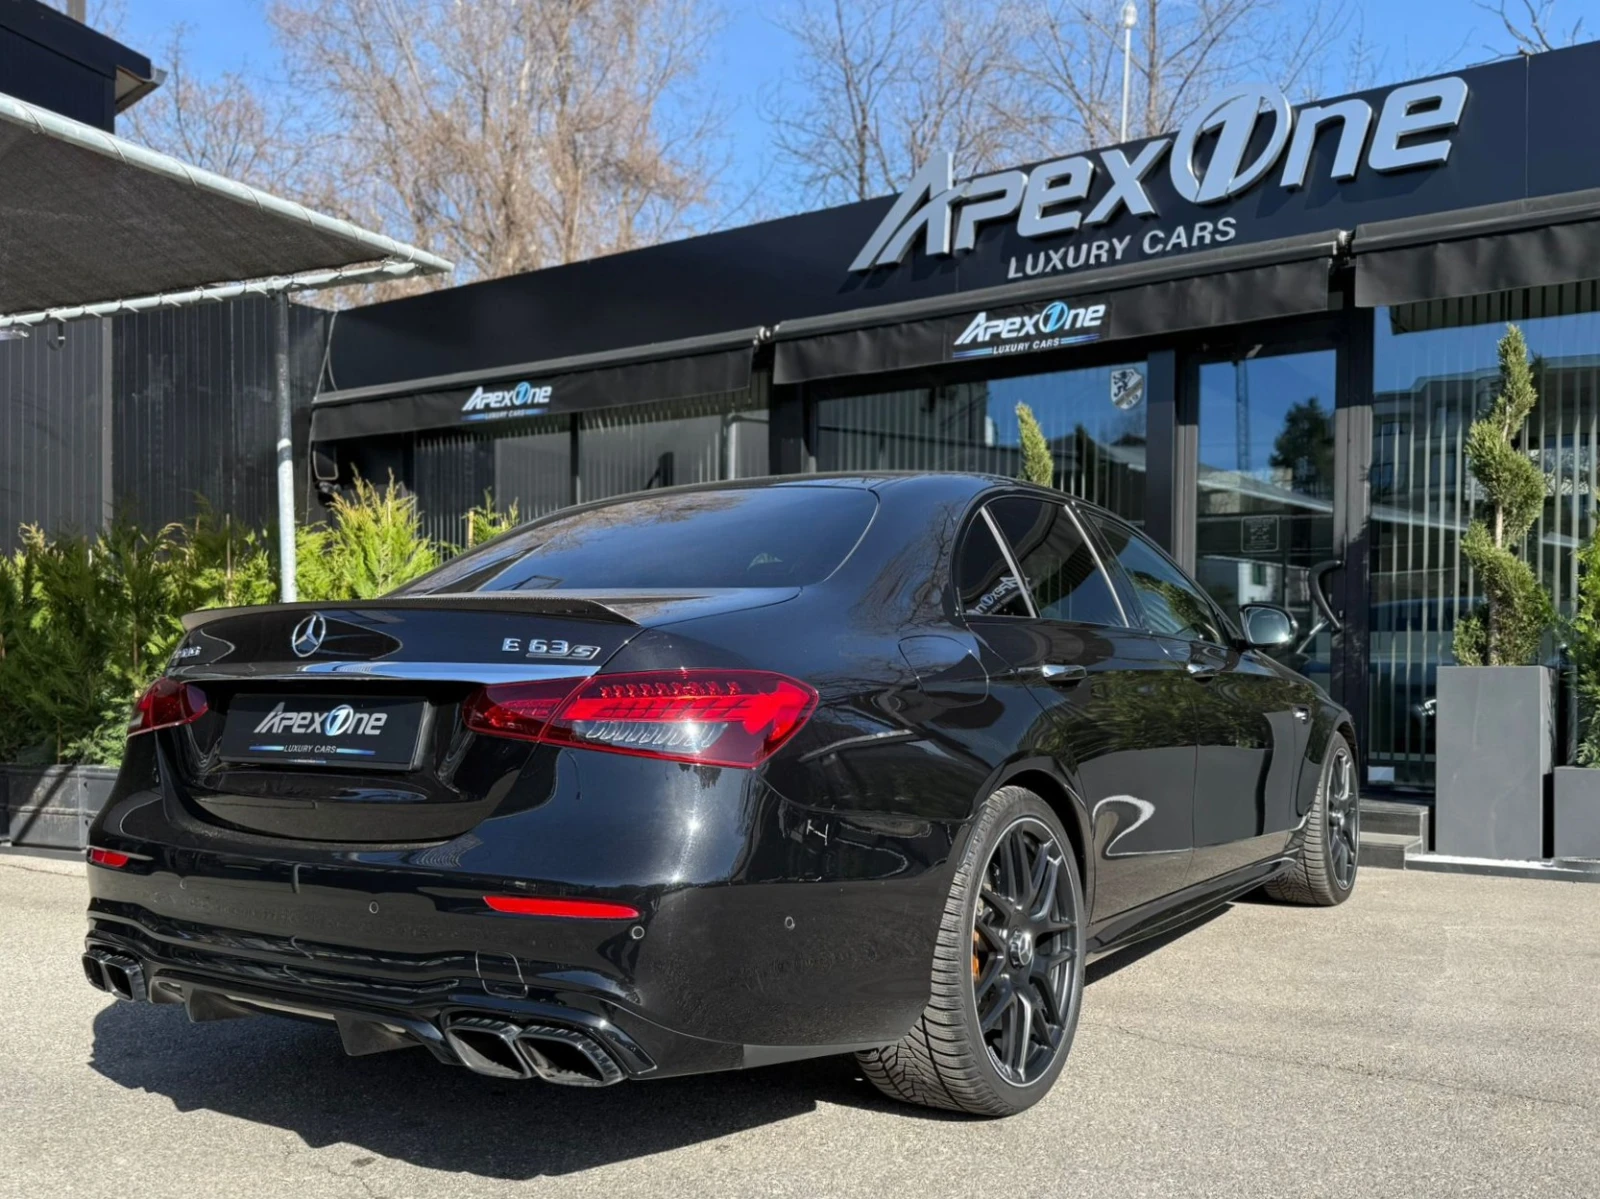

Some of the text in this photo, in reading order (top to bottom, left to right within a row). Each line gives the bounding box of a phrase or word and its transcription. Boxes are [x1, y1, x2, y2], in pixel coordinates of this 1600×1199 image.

[1007, 217, 1237, 279] LUXURY CARS
[993, 337, 1060, 354] LUXURY CARS
[502, 637, 521, 652] E
[284, 744, 337, 753] LUXURY CARS
